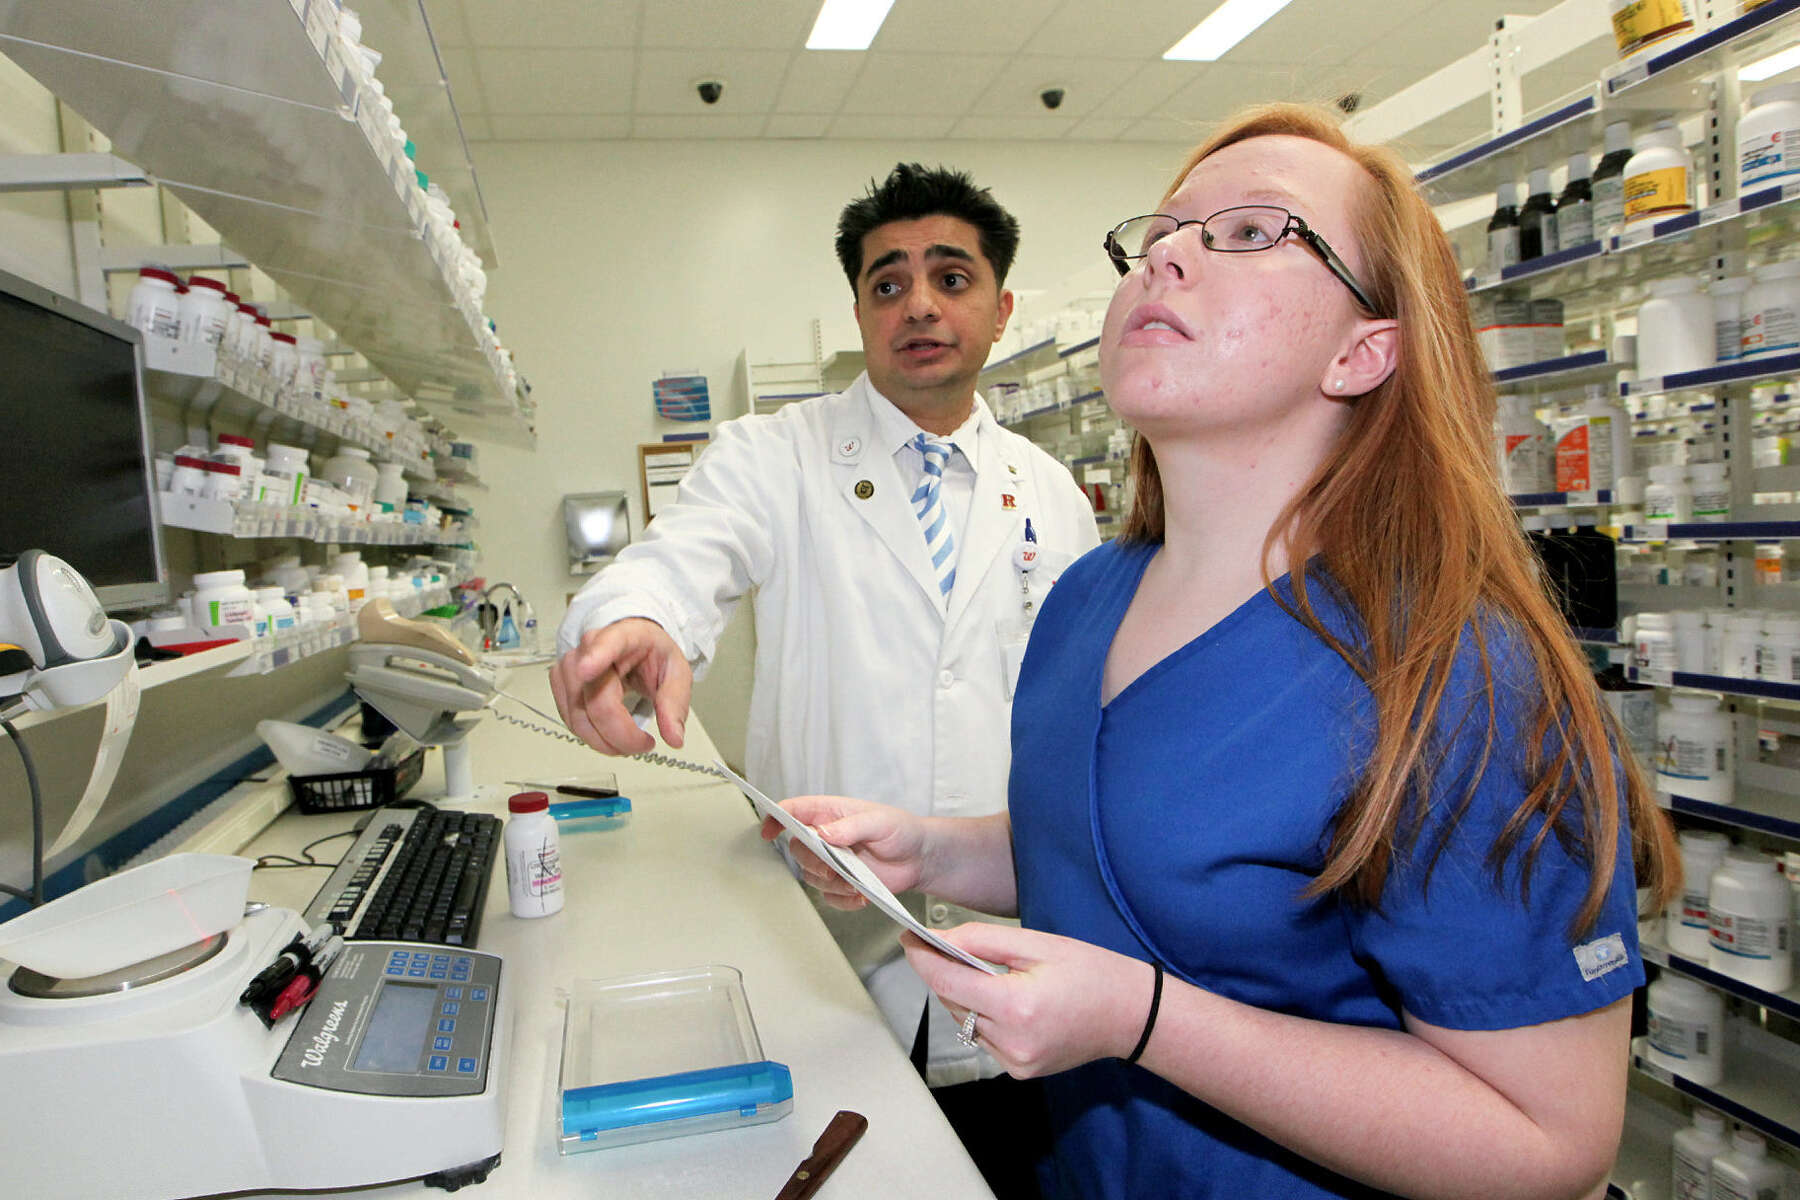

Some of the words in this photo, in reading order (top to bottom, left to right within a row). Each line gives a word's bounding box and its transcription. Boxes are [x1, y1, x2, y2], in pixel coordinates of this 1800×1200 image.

[1001, 493, 1017, 509] R
[1023, 551, 1037, 562] W
[300, 1000, 349, 1068] Walgreens
